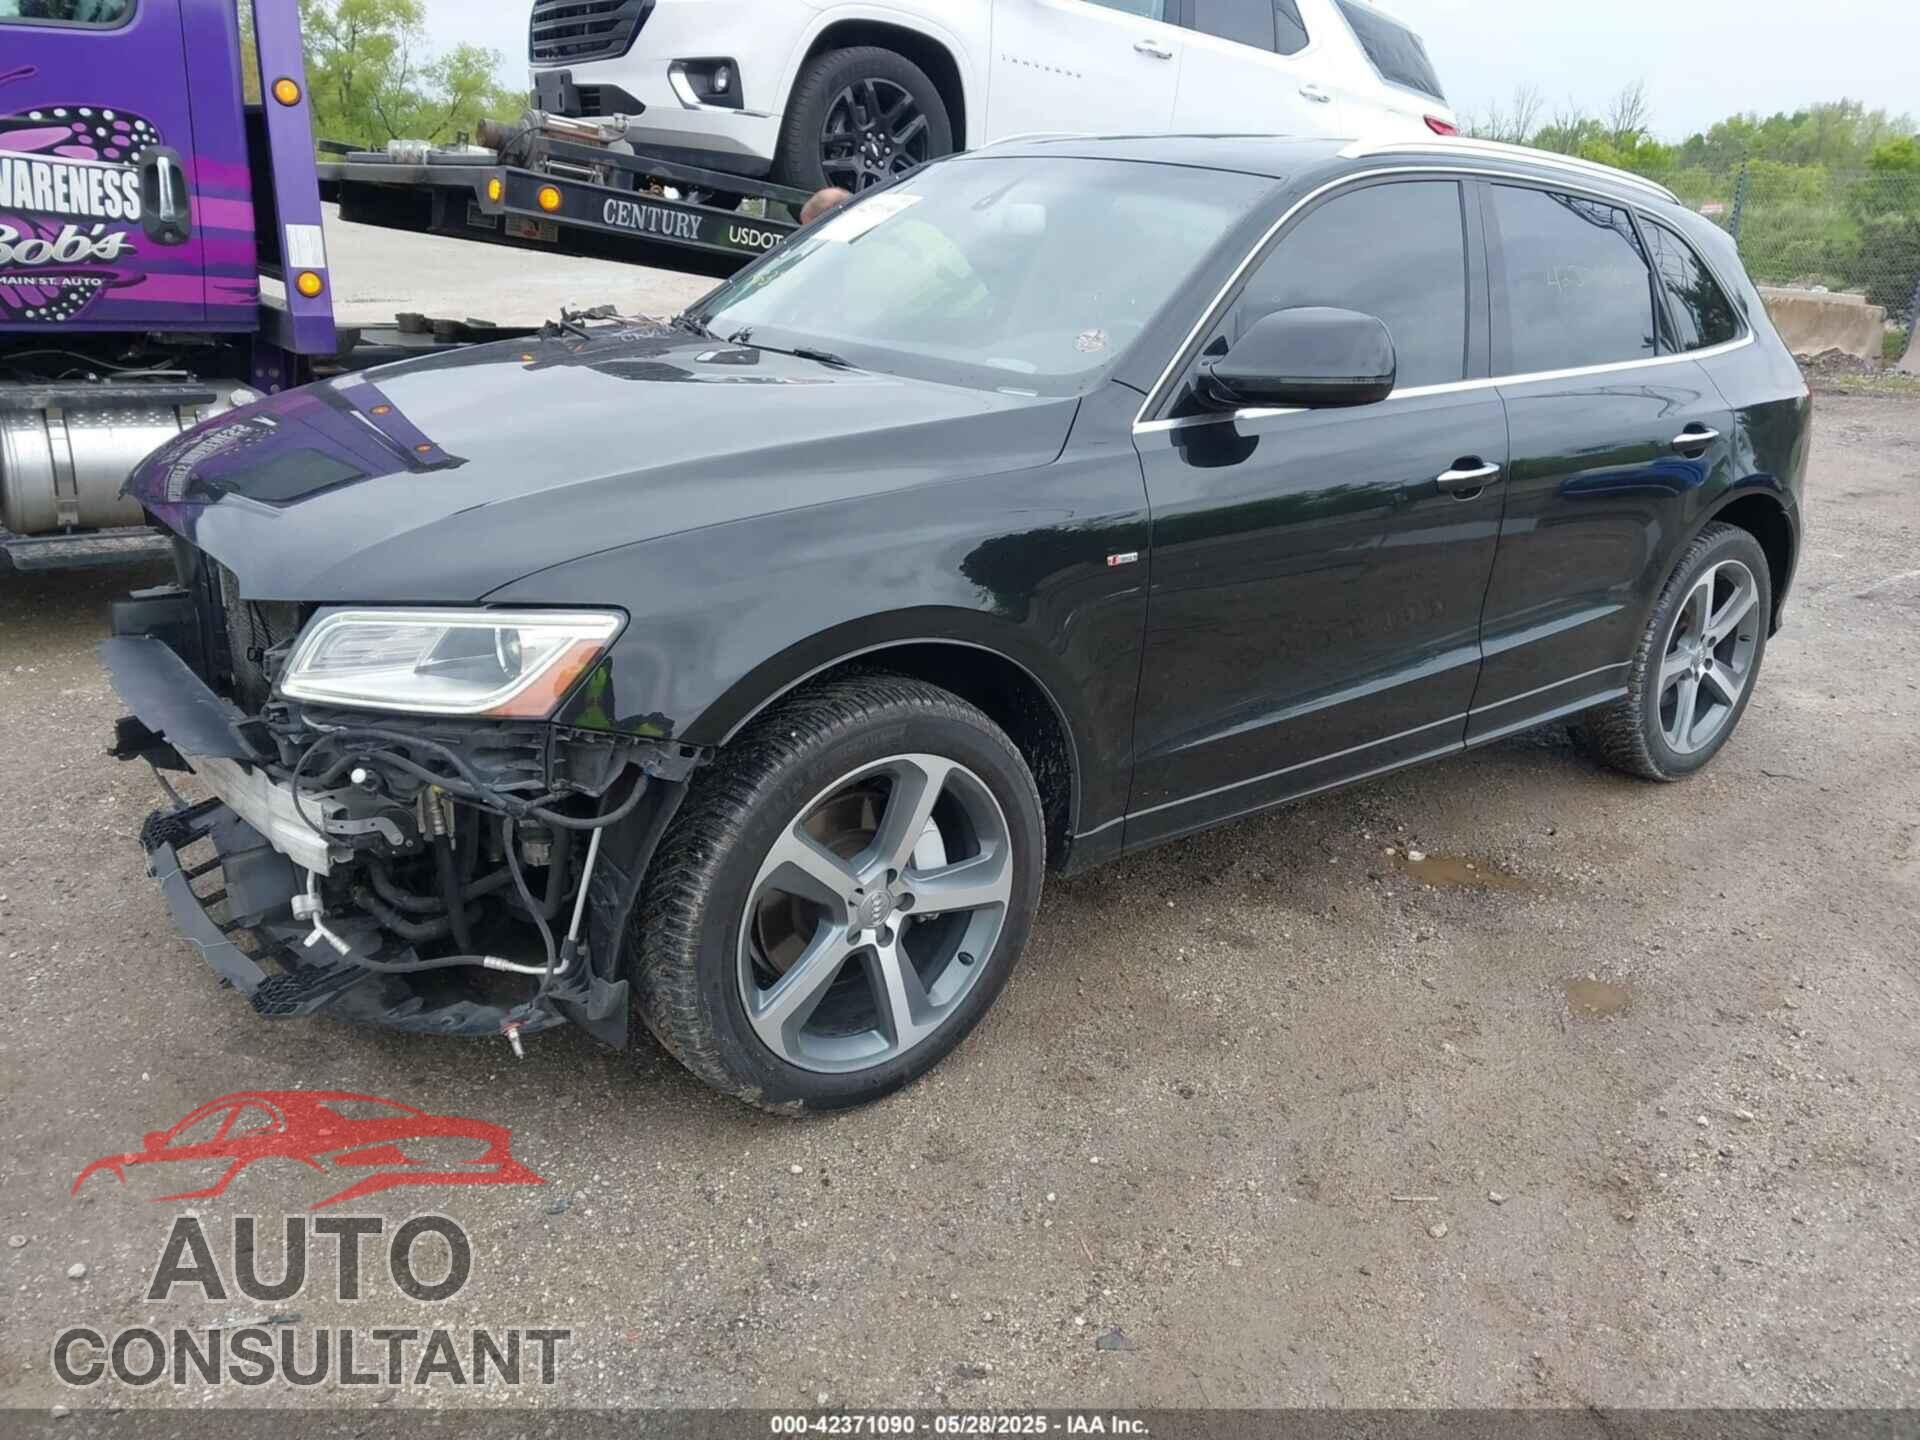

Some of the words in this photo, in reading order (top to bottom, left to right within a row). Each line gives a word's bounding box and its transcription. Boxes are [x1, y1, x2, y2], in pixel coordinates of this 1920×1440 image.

[602, 198, 702, 239] CENTURY
[728, 224, 784, 249] USDOT
[62, 277, 103, 286] AUTO
